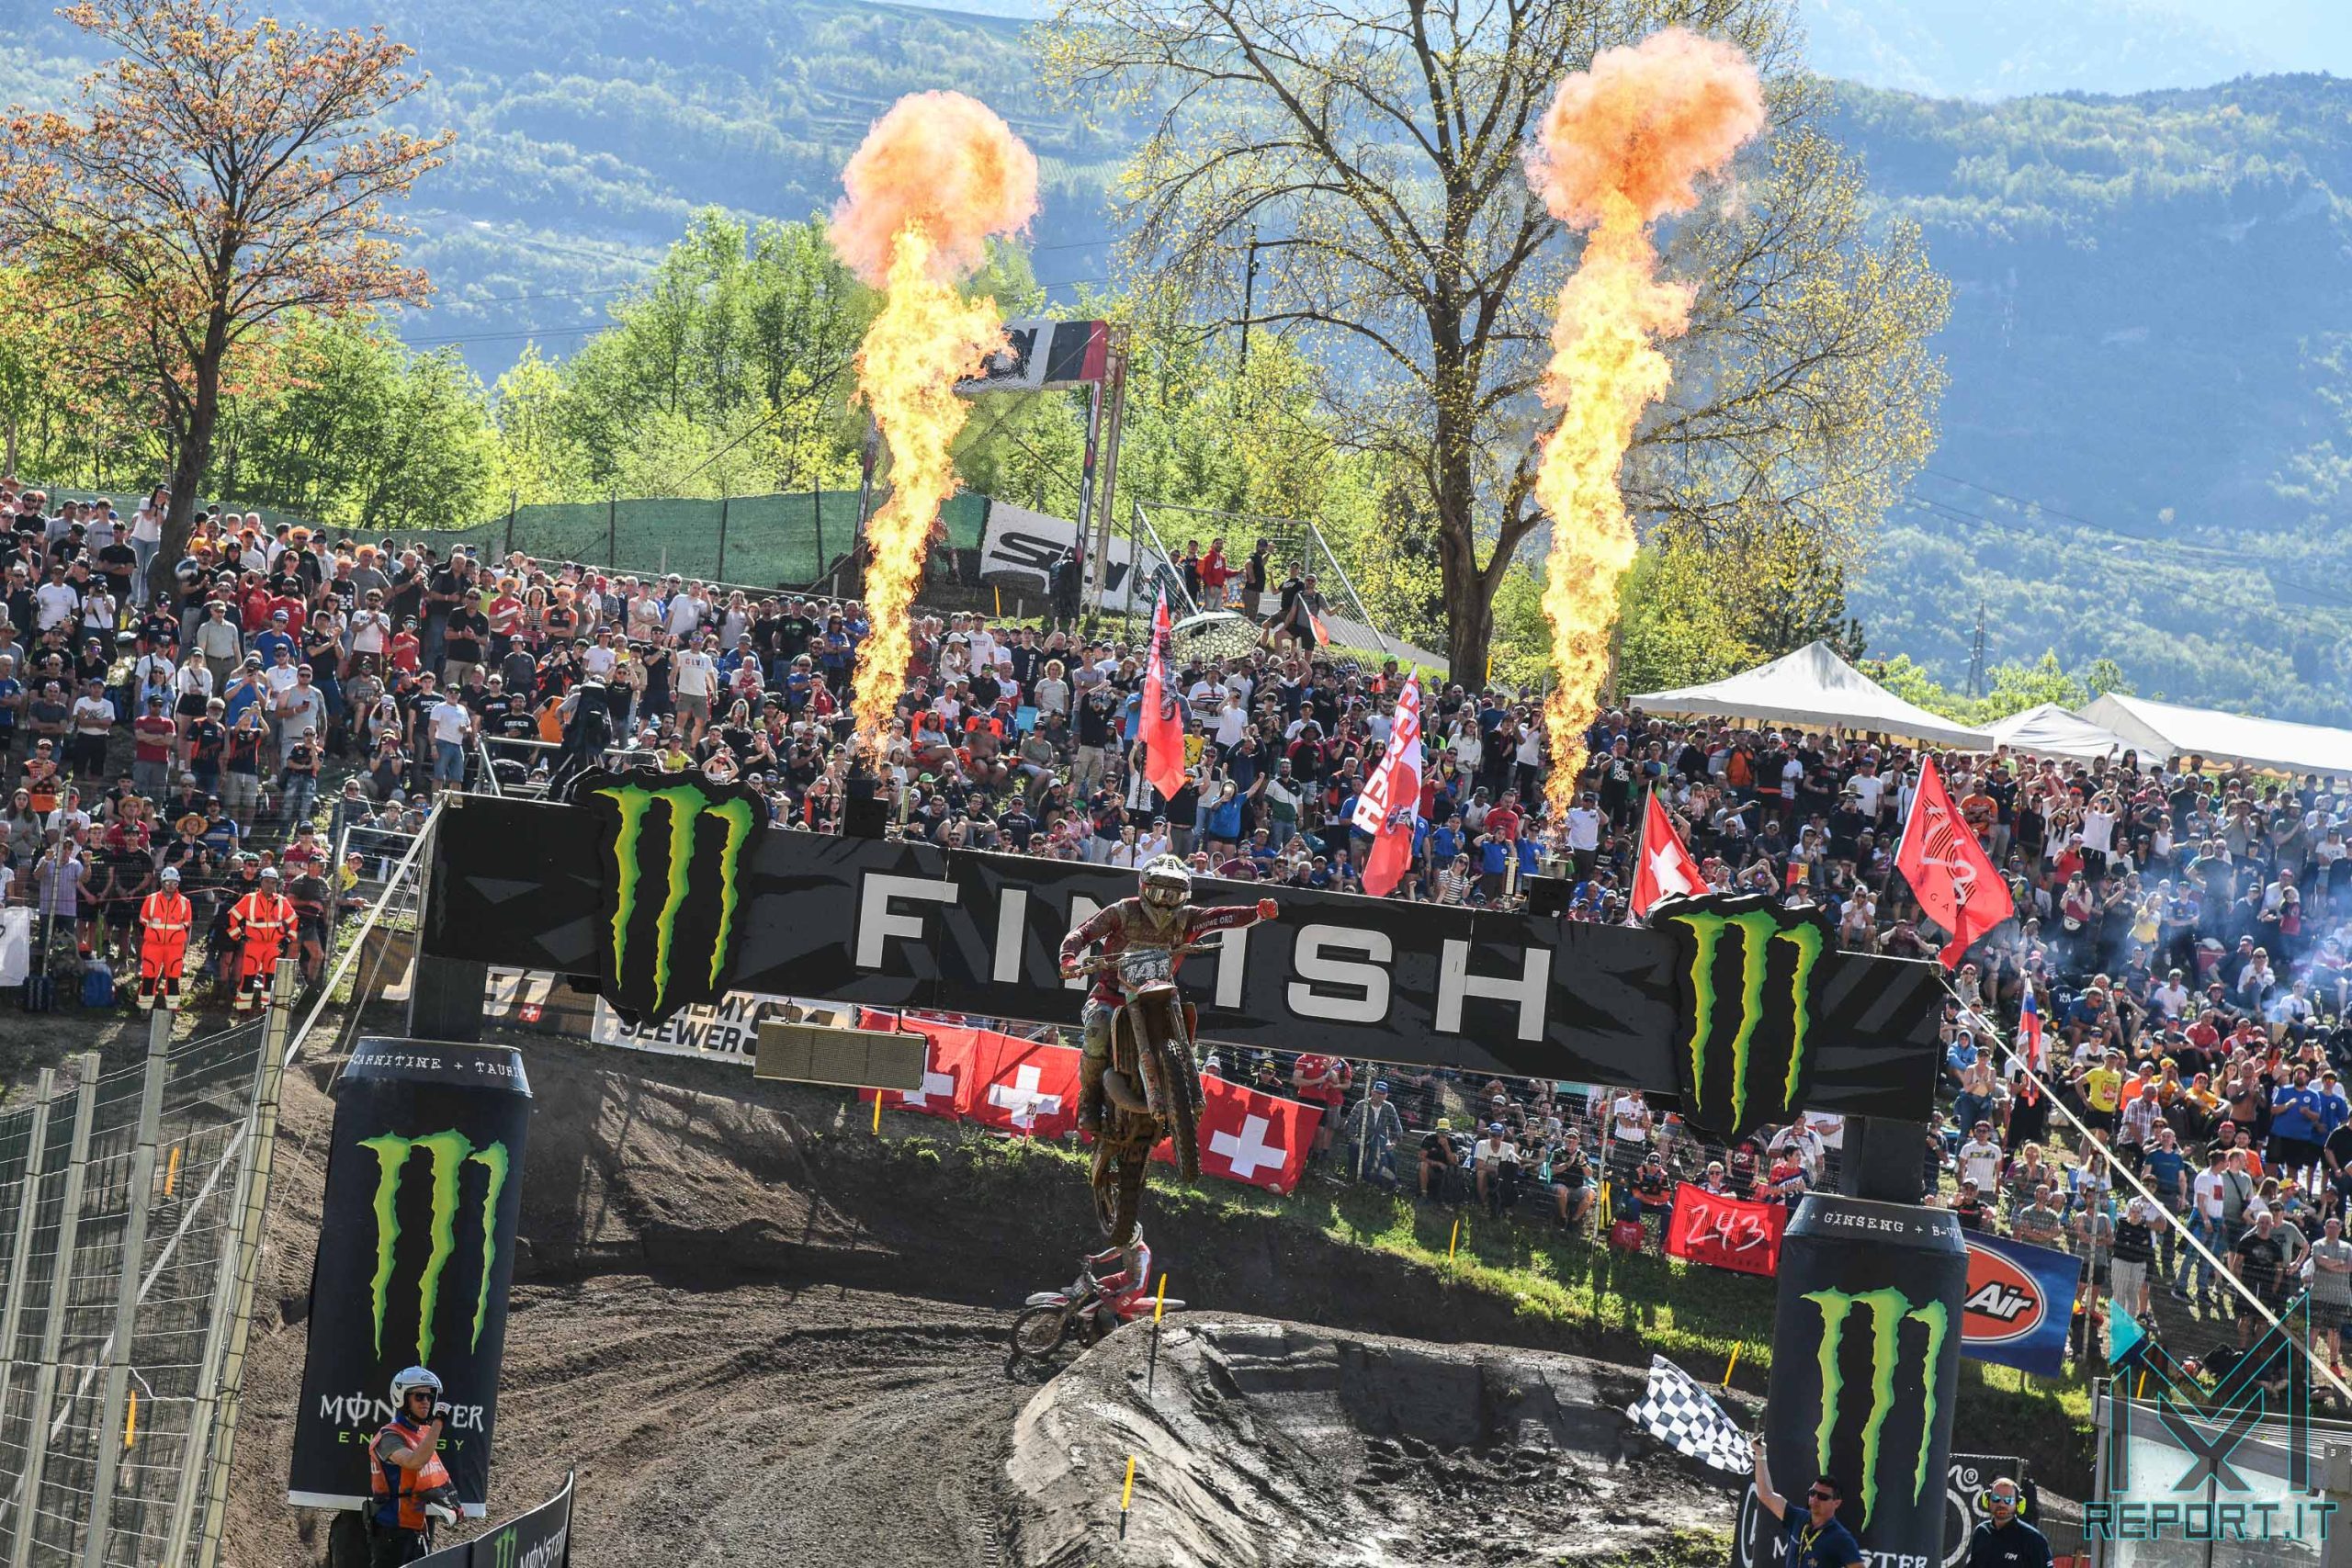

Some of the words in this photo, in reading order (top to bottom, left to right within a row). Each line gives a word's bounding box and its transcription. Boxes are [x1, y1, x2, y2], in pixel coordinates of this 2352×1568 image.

[1219, 915, 1233, 925] ORO
[1026, 1103, 1037, 1116] 20
[1686, 1203, 1766, 1252] 243
[1823, 1211, 1905, 1233] GINSENG
[1963, 1283, 2032, 1319] Air
[319, 1391, 485, 1433] MONER
[338, 1431, 465, 1451] ENGY
